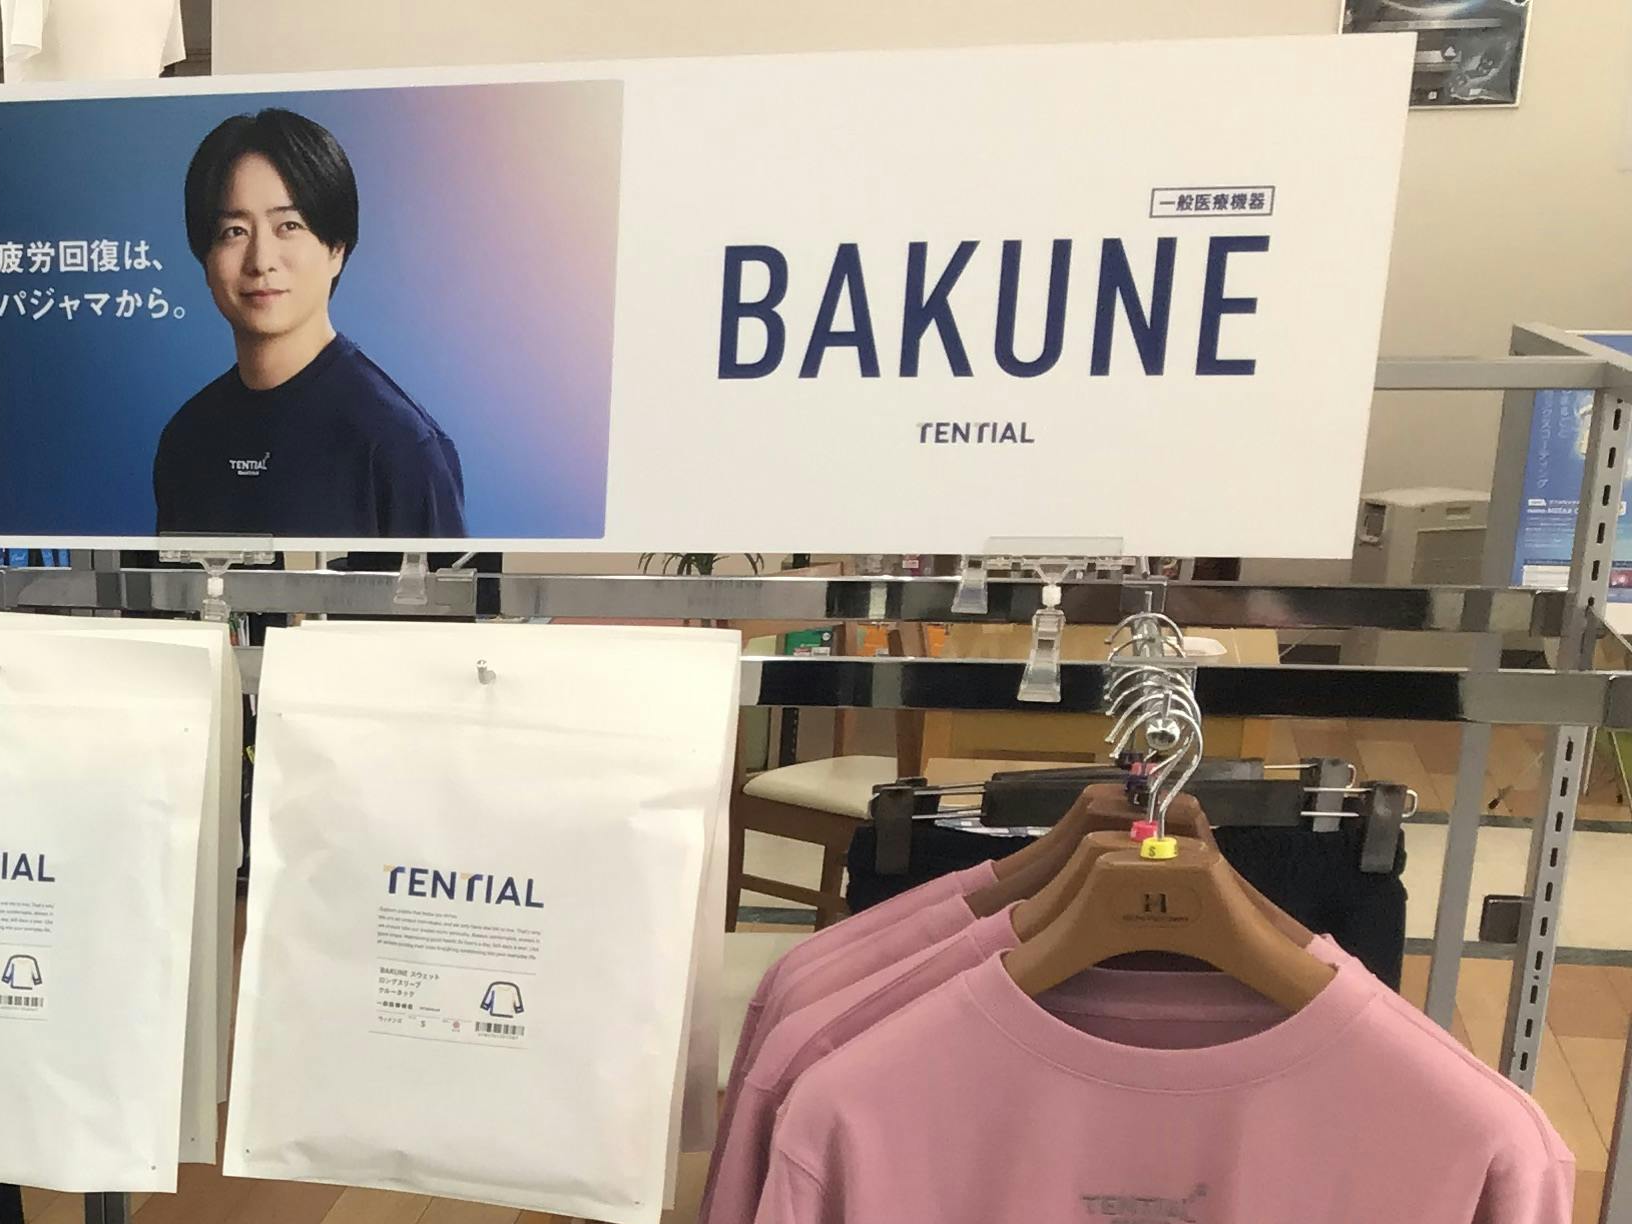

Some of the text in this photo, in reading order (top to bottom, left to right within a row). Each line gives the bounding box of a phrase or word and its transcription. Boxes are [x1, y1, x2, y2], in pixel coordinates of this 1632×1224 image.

[1157, 192, 1266, 214] 一般医療機器
[716, 234, 1272, 381] BAKUNE
[915, 420, 1036, 445] TENTIAL
[383, 864, 545, 909] TENTIAL
